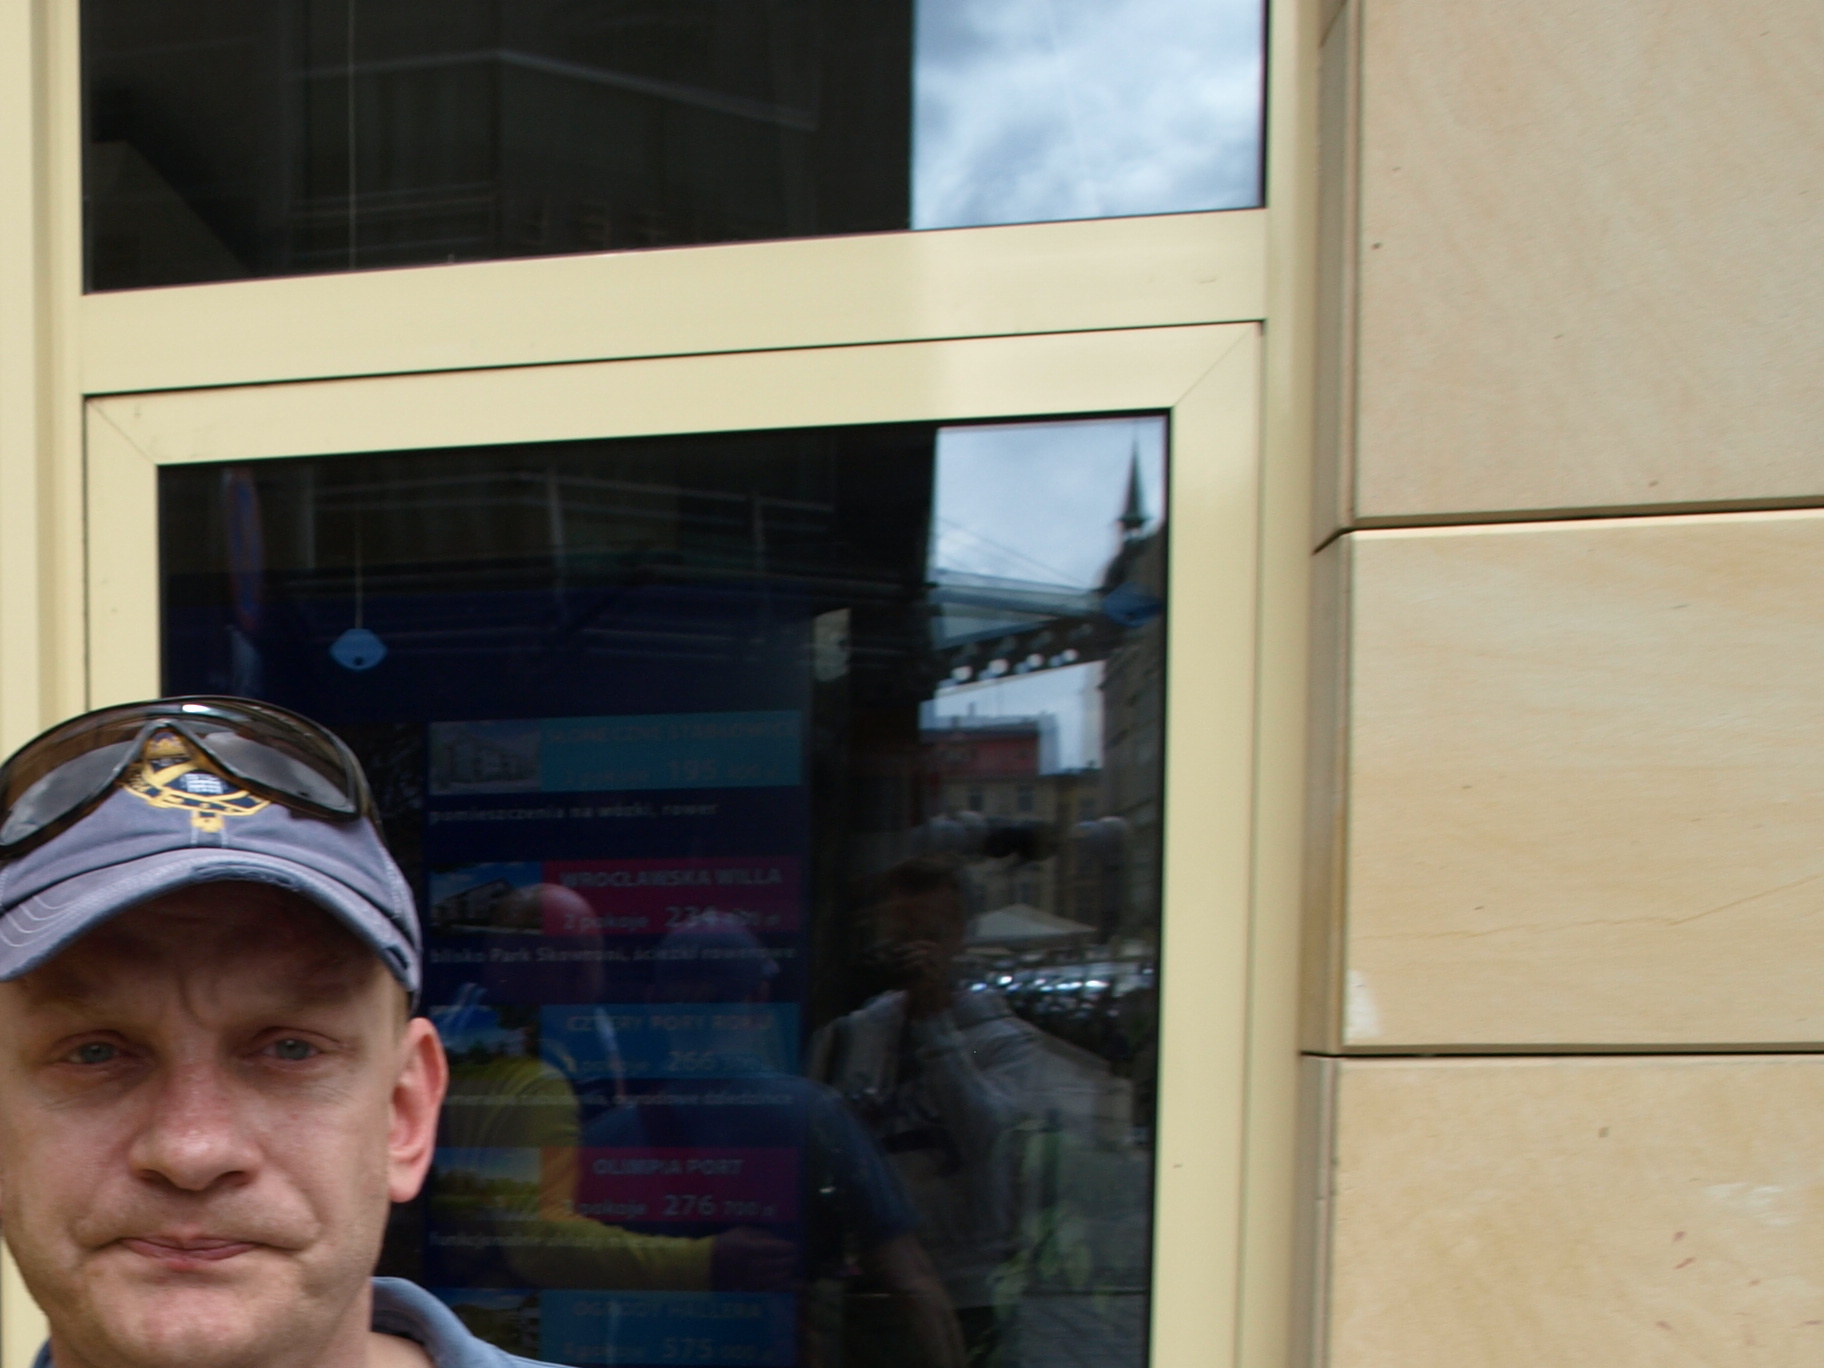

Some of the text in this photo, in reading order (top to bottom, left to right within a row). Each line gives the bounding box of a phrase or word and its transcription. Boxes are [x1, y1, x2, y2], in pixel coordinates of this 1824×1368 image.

[666, 758, 718, 782] 195
[714, 867, 783, 886] WILLA
[489, 948, 530, 962] Park
[592, 1157, 745, 1175] OLIMPIA PORT
[663, 1194, 718, 1217] 276
[572, 1299, 663, 1317] OGODY
[661, 1336, 714, 1360] 575
